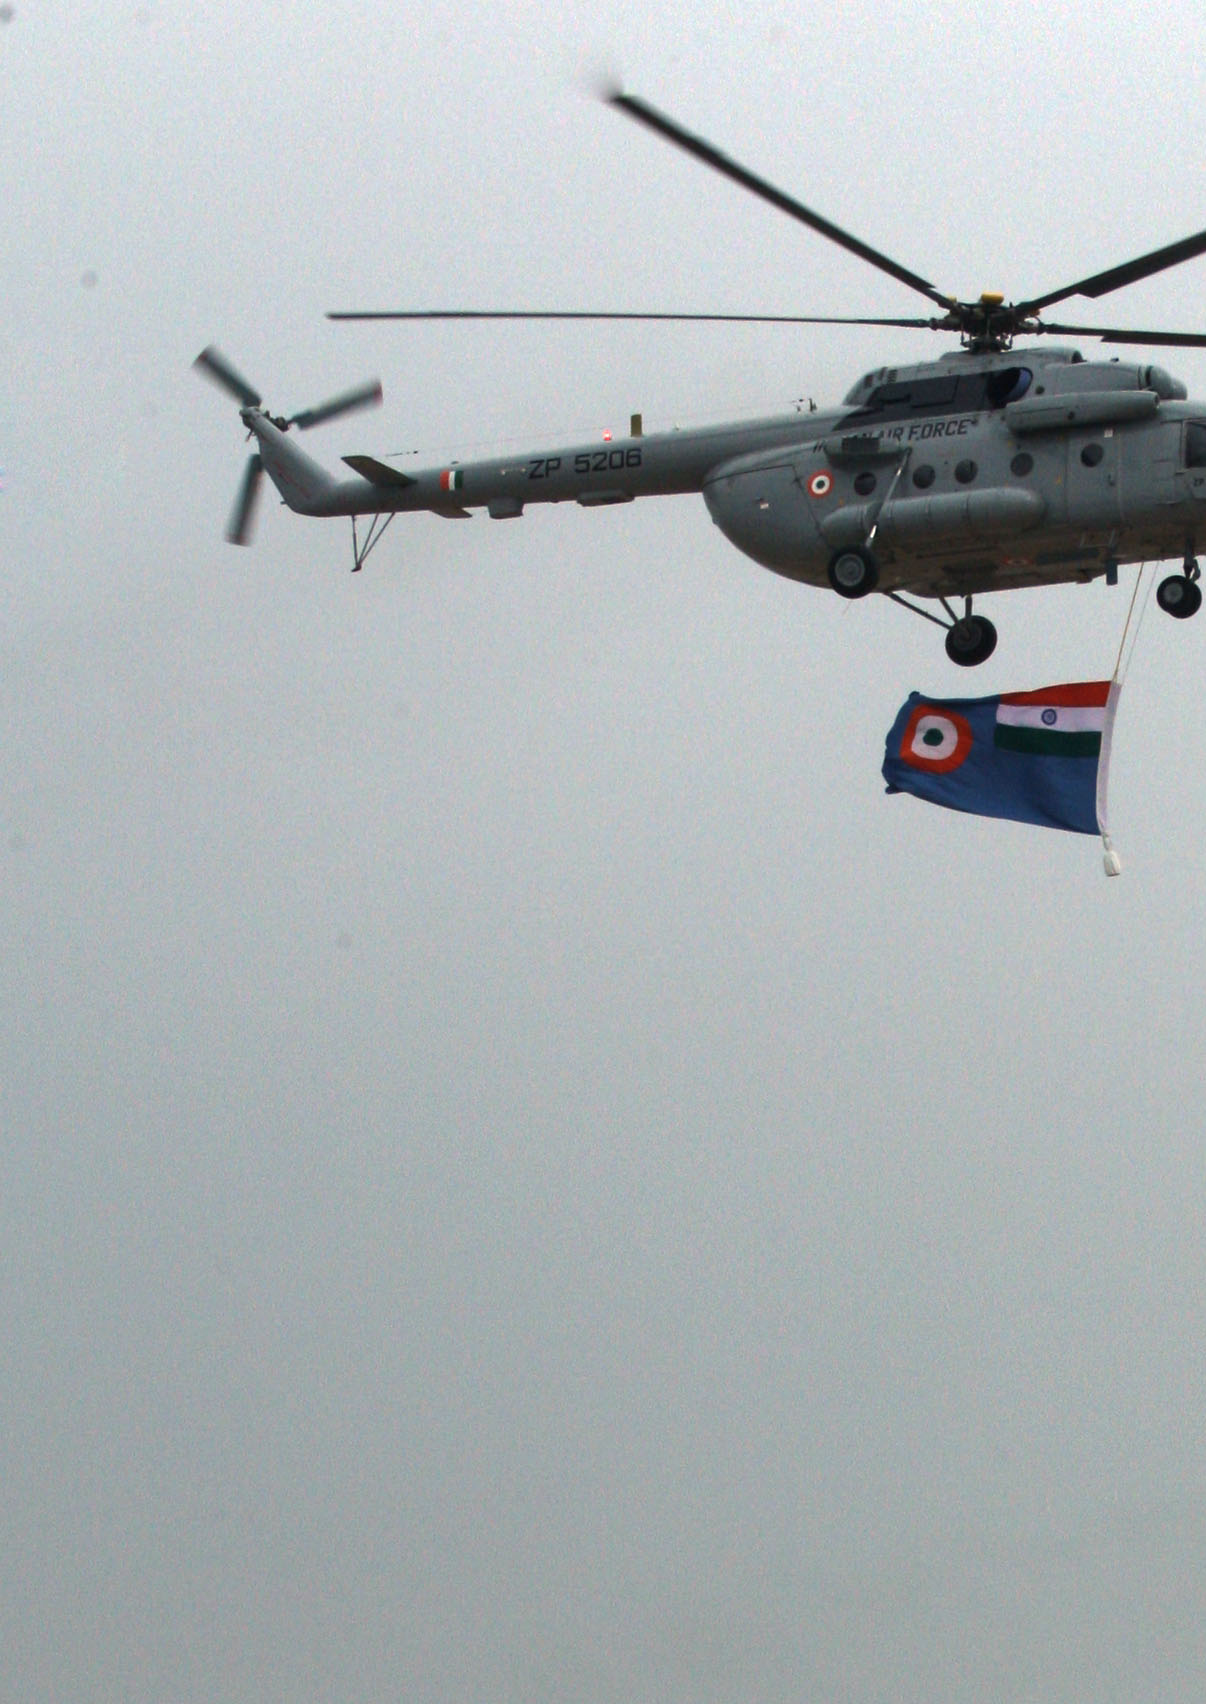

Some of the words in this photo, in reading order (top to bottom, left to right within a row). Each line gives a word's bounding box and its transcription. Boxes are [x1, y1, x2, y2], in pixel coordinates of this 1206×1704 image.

[908, 419, 970, 441] FORCE
[528, 458, 561, 479] ZP
[574, 448, 642, 474] 5206
